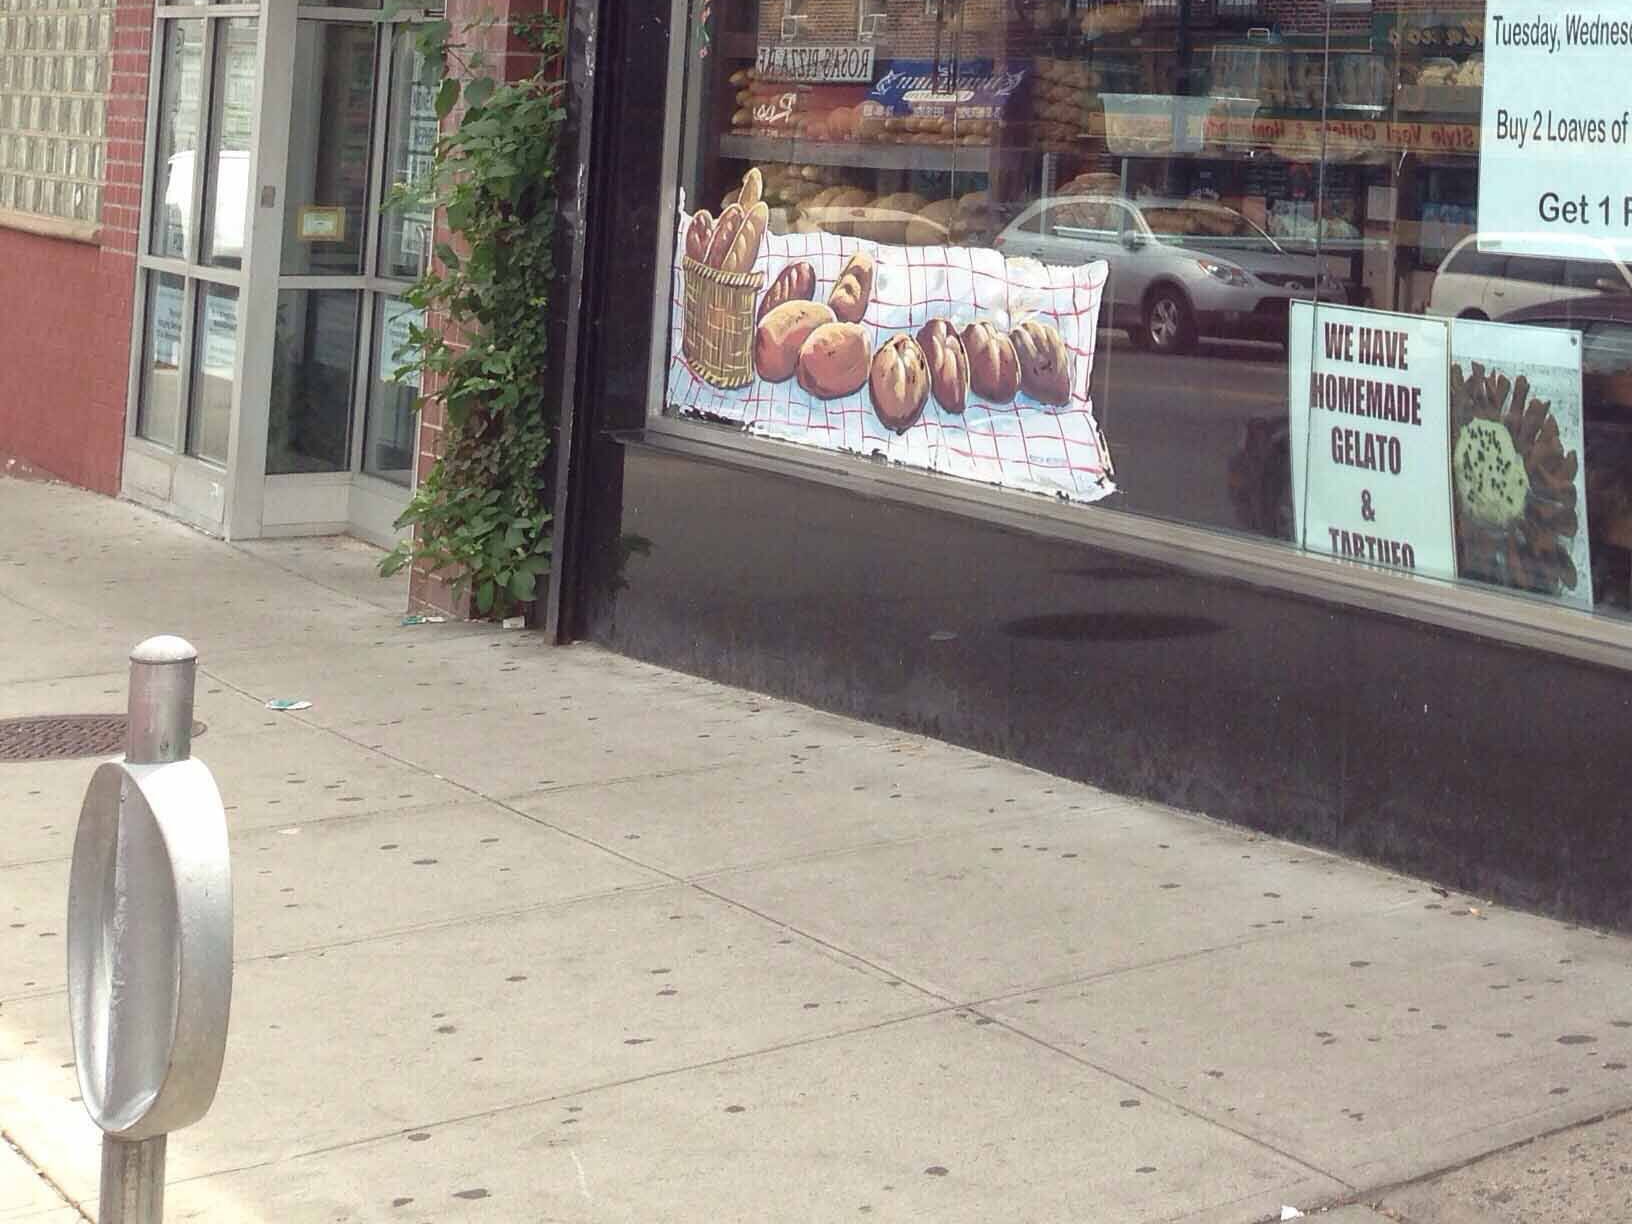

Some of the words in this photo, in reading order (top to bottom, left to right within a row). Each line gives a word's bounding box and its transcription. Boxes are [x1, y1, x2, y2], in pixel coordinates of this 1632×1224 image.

[1493, 14, 1560, 54] Tuesday,
[1497, 110, 1528, 150] Buy
[1533, 110, 1542, 142] 2
[1547, 111, 1605, 144] Loaves
[1611, 111, 1628, 144] of
[1539, 192, 1588, 223] Get
[1598, 193, 1611, 224] 1
[1324, 322, 1354, 362] WE
[1358, 327, 1409, 370] HAVE
[1311, 372, 1422, 426] HOMEMADE
[1331, 426, 1401, 475] GELATO
[1361, 490, 1376, 522] &
